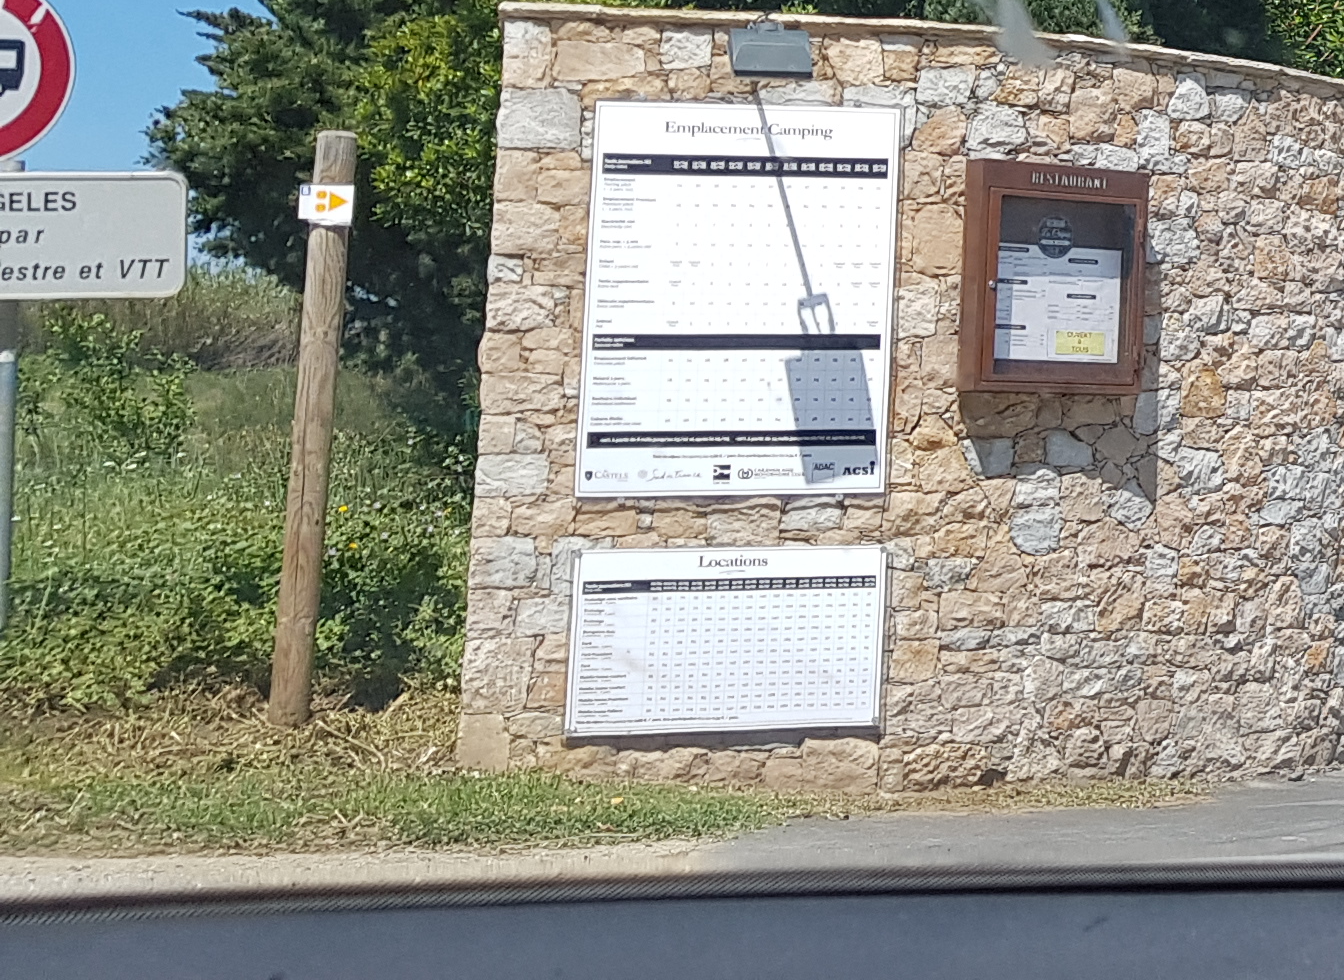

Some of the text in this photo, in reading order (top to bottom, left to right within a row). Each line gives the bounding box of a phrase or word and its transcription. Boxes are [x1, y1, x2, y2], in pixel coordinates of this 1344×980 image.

[664, 121, 834, 140] Emplacement Camping
[1031, 171, 1107, 189] RESTAURANT
[0, 258, 170, 281] estre et VTT
[698, 554, 769, 569] Locations
